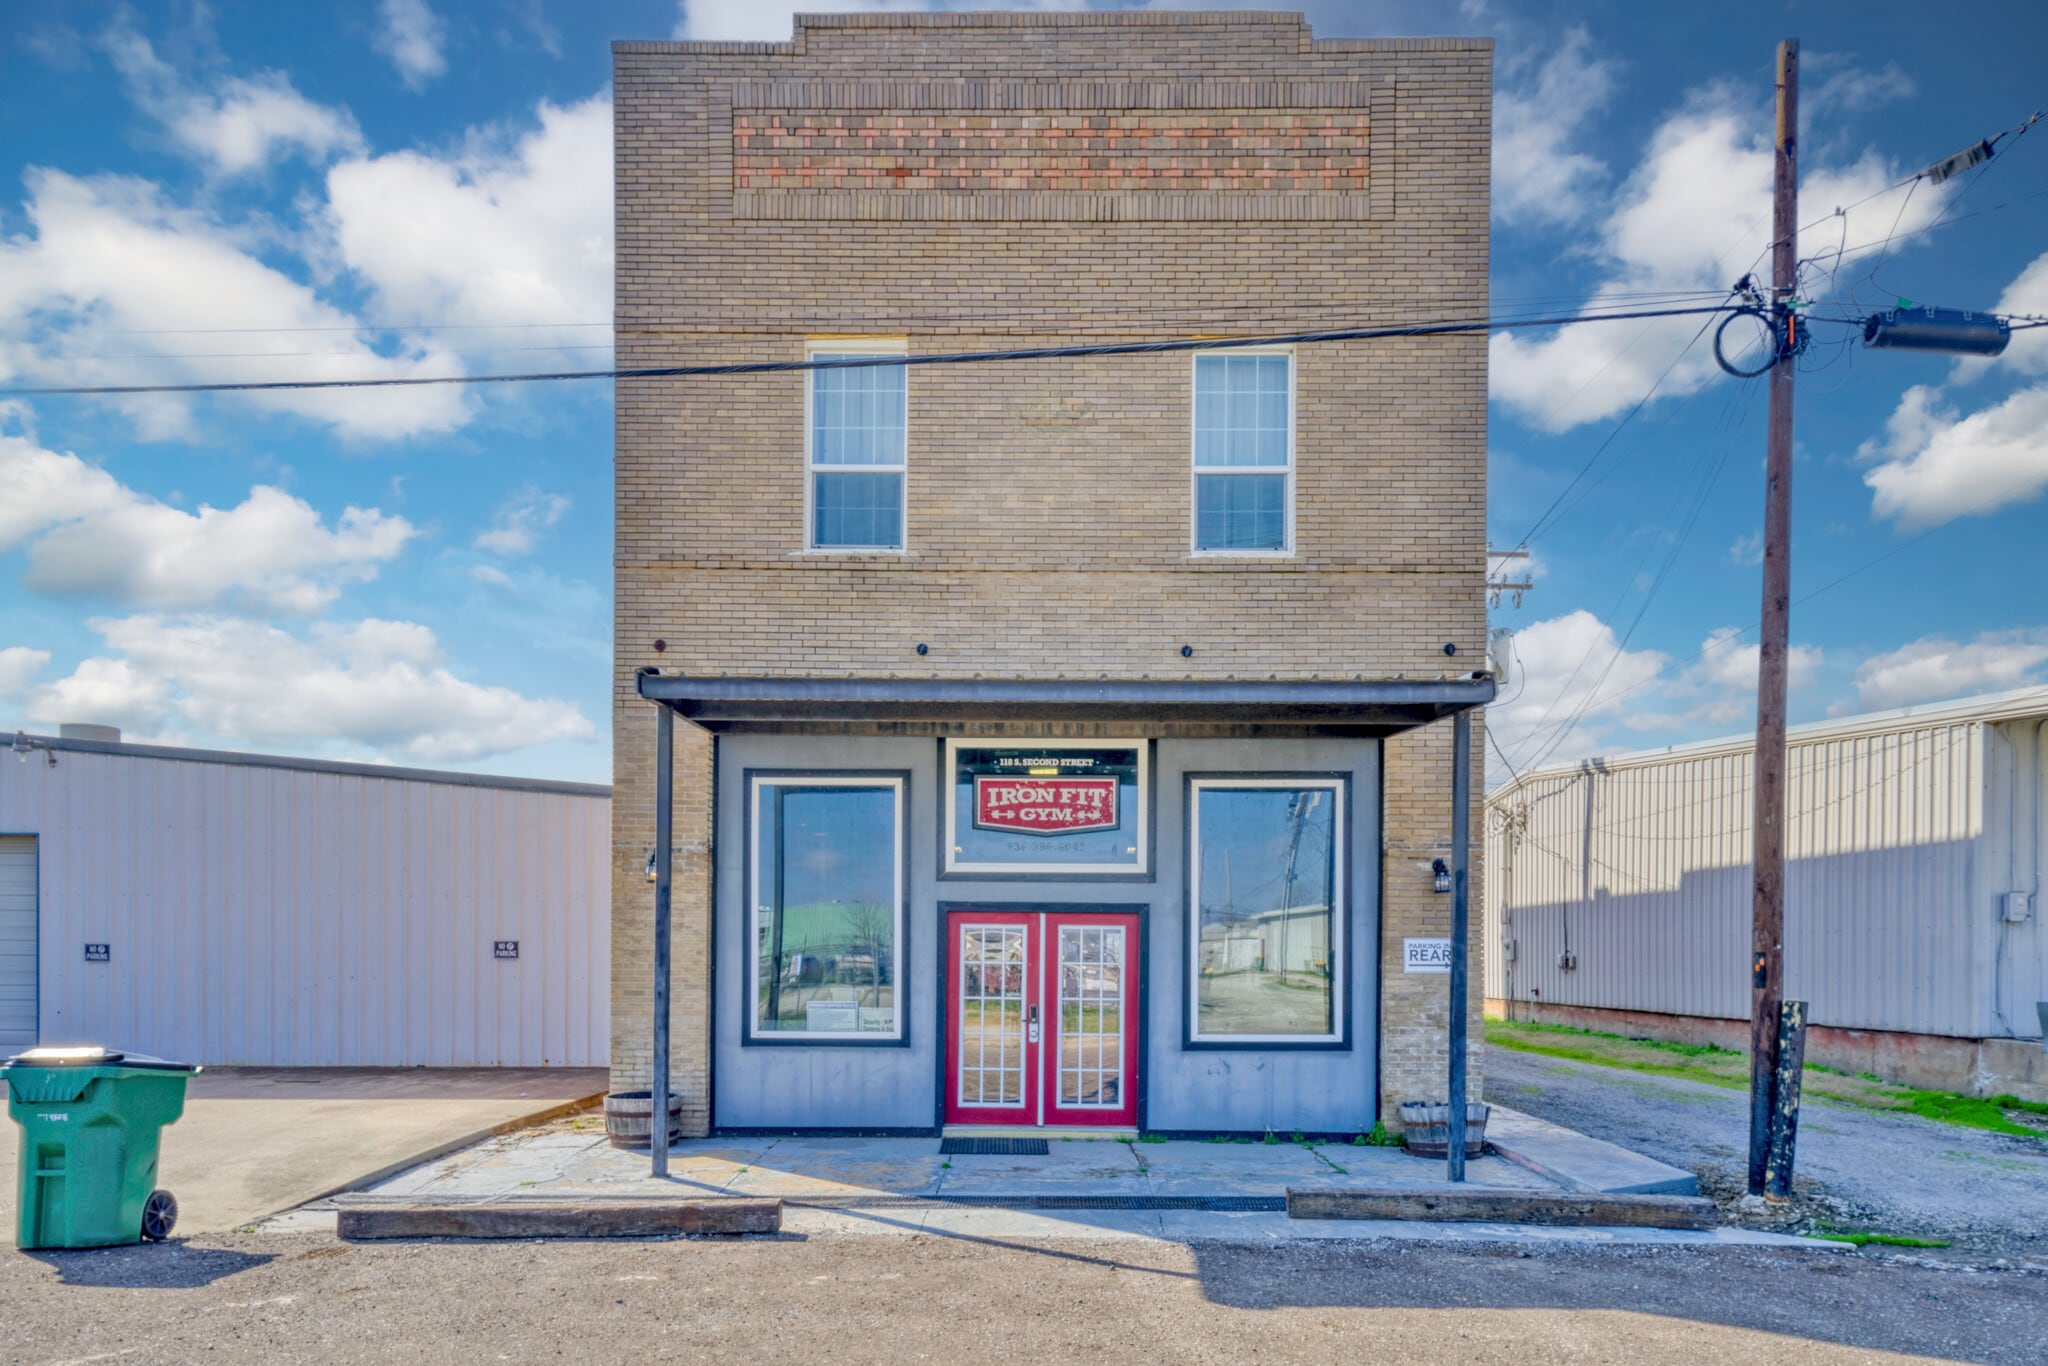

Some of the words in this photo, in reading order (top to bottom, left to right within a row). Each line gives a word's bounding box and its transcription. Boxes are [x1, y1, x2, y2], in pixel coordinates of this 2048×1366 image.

[1022, 758, 1059, 766] SECOND
[1060, 758, 1094, 766] STREET
[987, 787, 1056, 807] IRON
[1059, 787, 1108, 807] FIT
[1019, 808, 1073, 821] GYM
[1409, 949, 1452, 961] REAR
